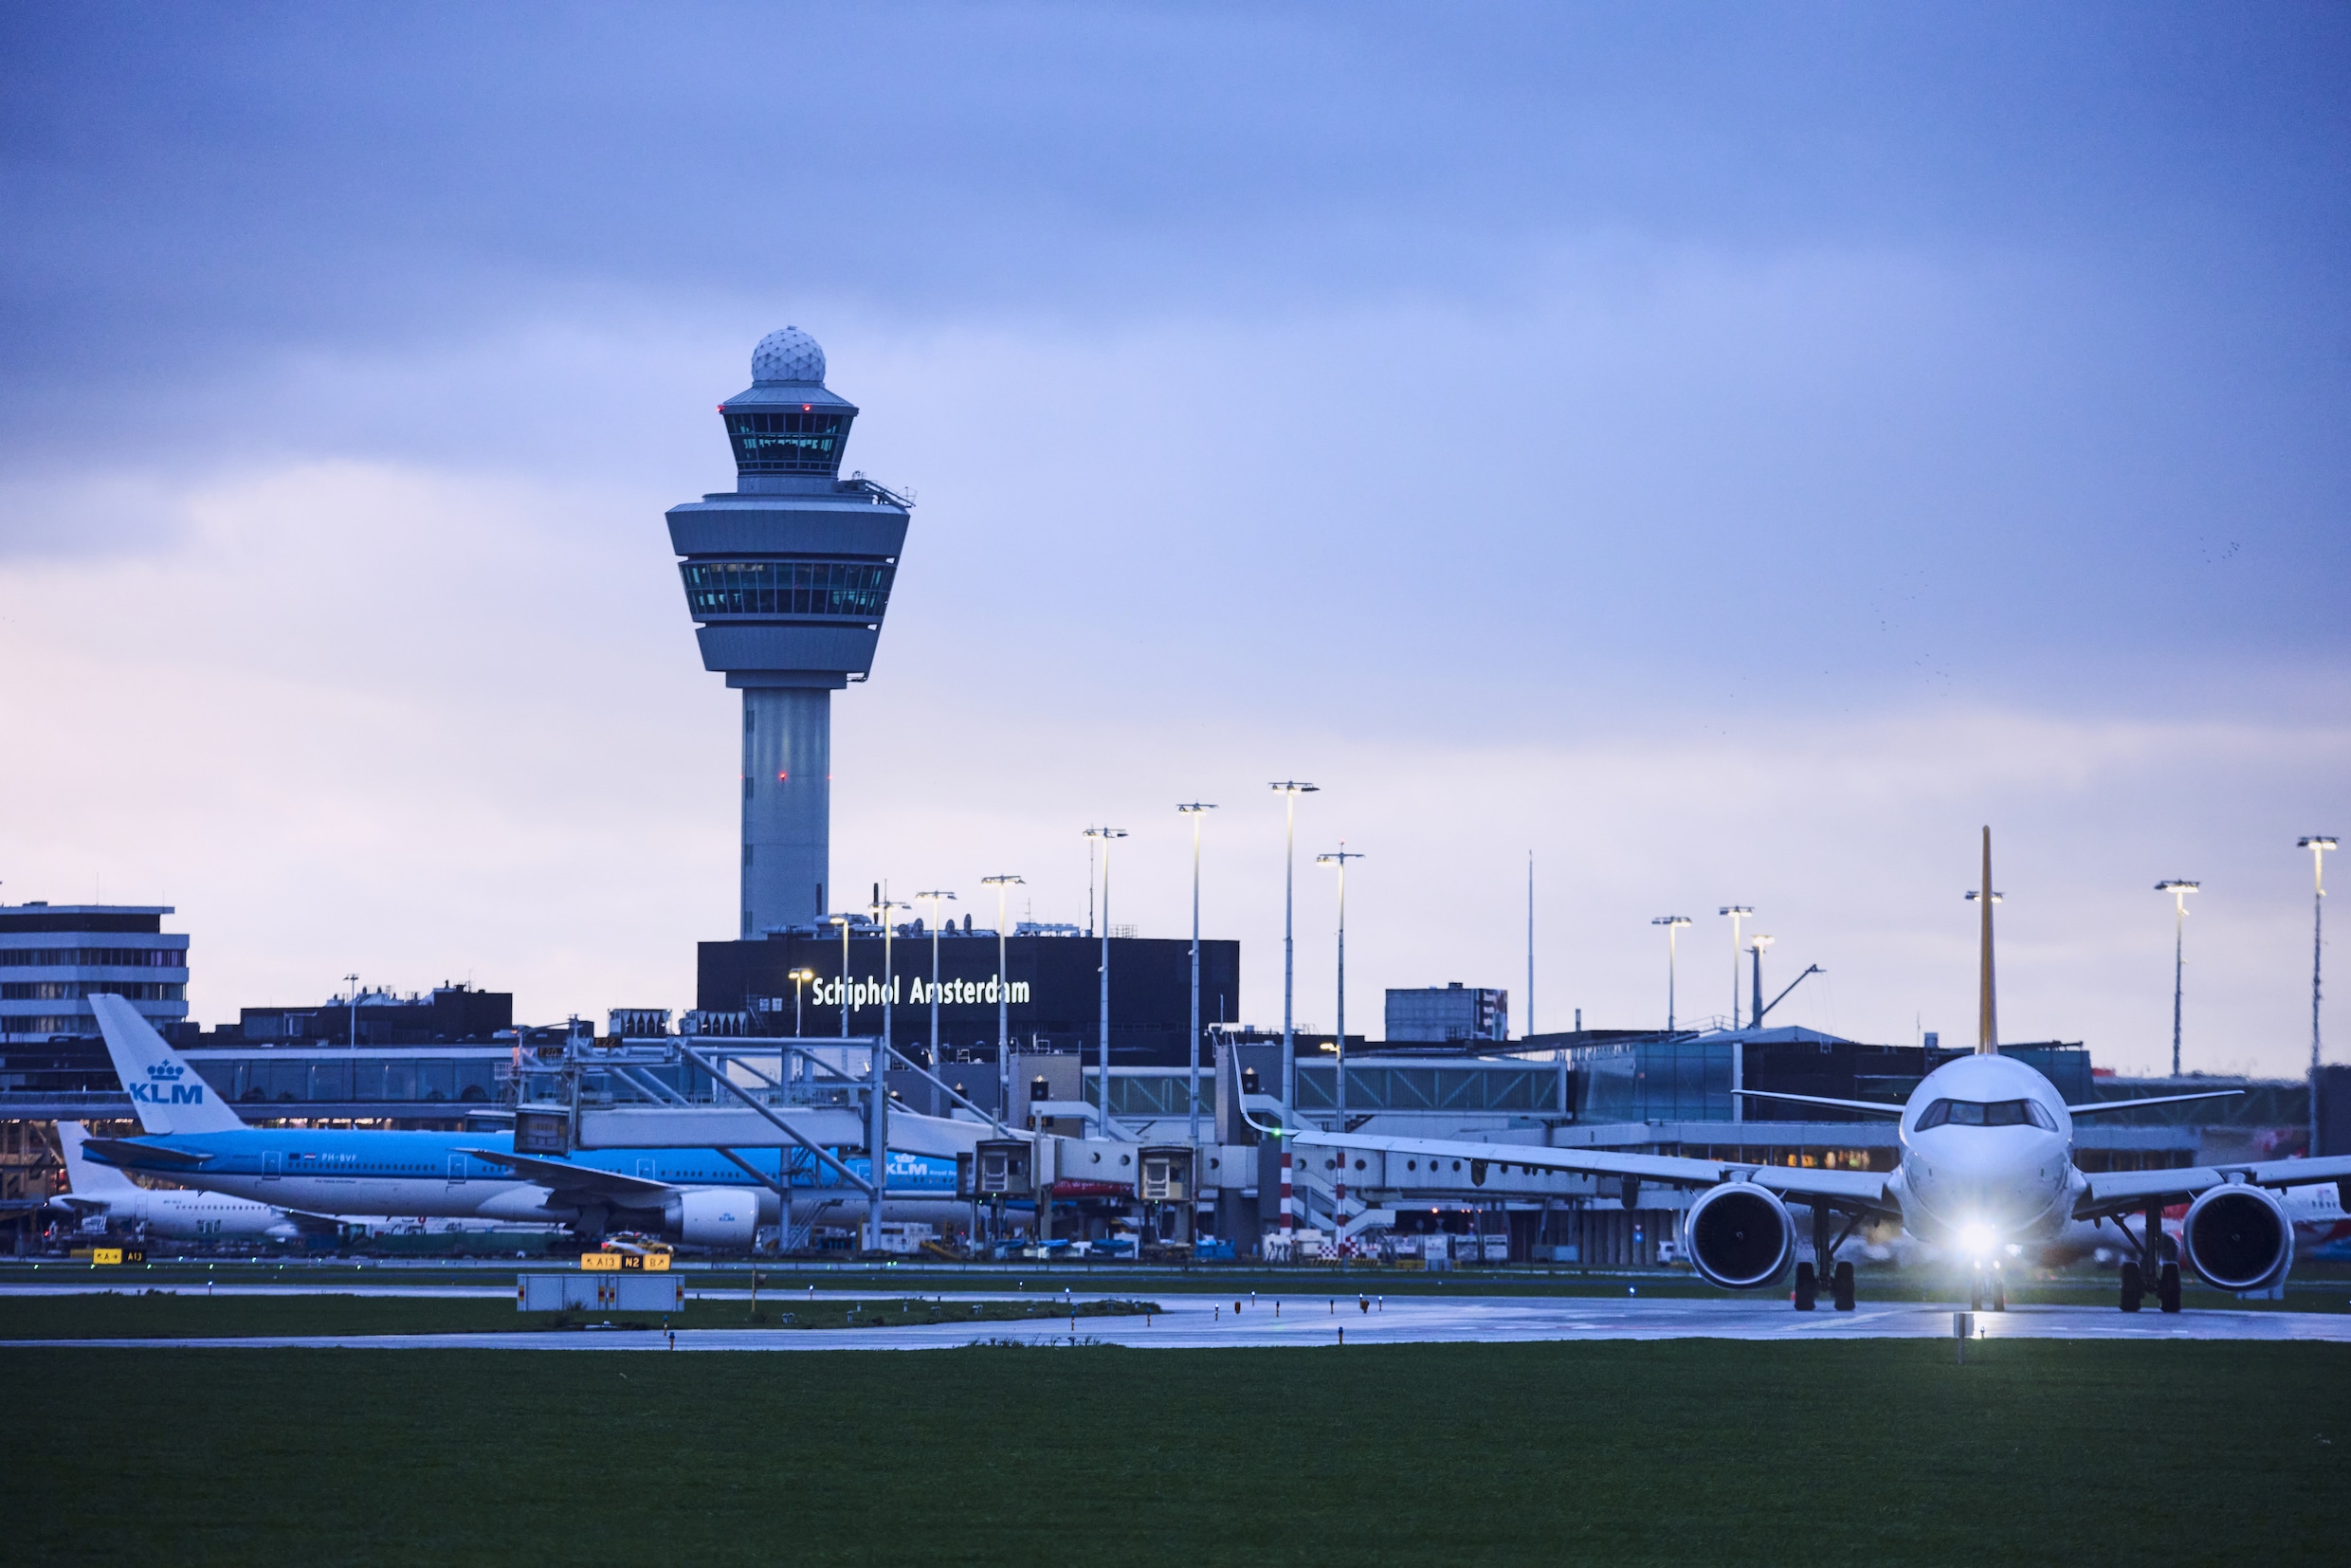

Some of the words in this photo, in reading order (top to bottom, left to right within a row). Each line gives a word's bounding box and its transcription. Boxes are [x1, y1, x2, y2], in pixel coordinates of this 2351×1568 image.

[812, 975, 900, 1012] Schiphol
[909, 974, 1030, 1005] Amsterdam
[595, 1037, 615, 1048] E22
[129, 1083, 203, 1104] KLM
[1029, 1117, 1048, 1127] E4
[886, 1163, 927, 1176] KLM
[128, 1252, 142, 1262] A13
[625, 1257, 640, 1267] N2
[596, 1258, 615, 1267] A13
[649, 1258, 656, 1267] B
